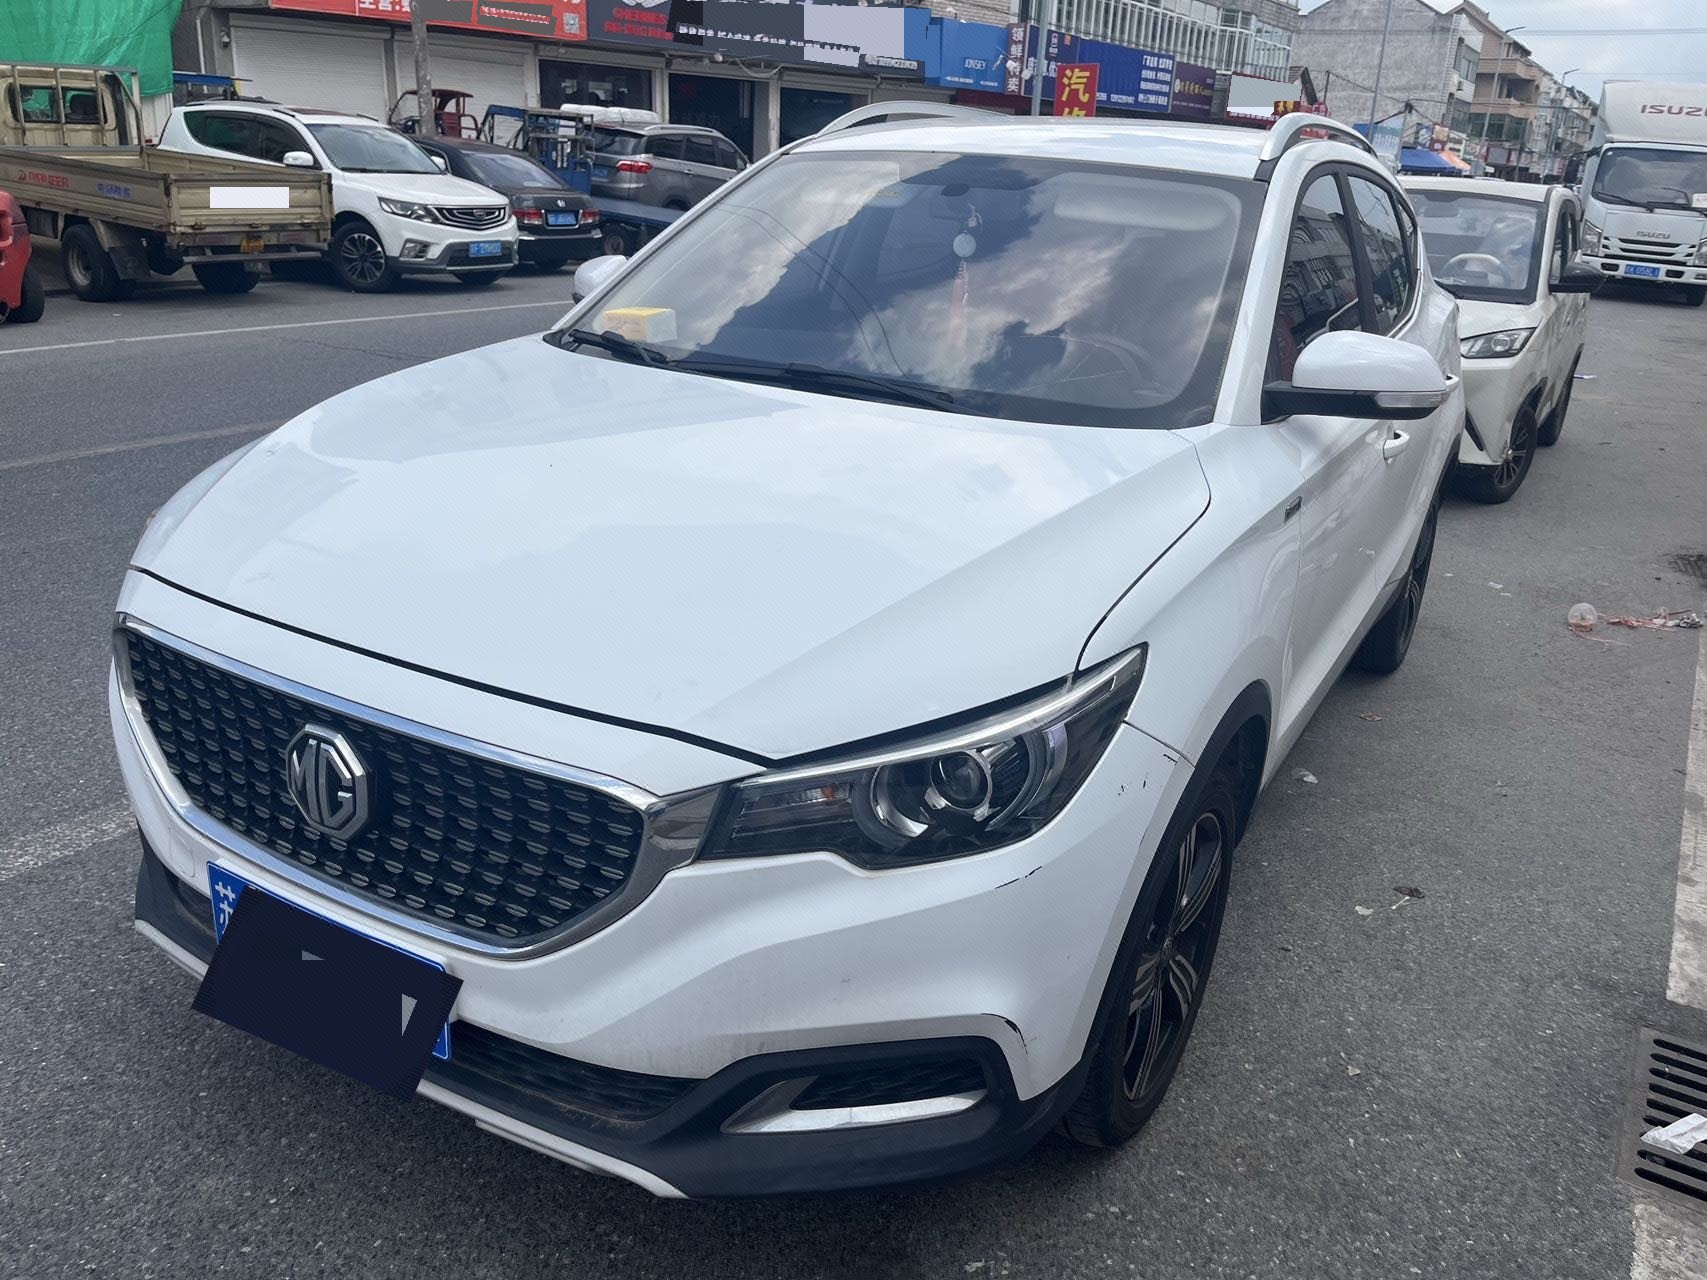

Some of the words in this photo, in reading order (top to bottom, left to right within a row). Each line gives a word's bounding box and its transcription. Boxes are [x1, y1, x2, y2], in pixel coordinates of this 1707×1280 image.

[1641, 104, 1707, 117] ISUZ
[1636, 230, 1671, 240] ISUZU
[291, 737, 354, 832] MG
